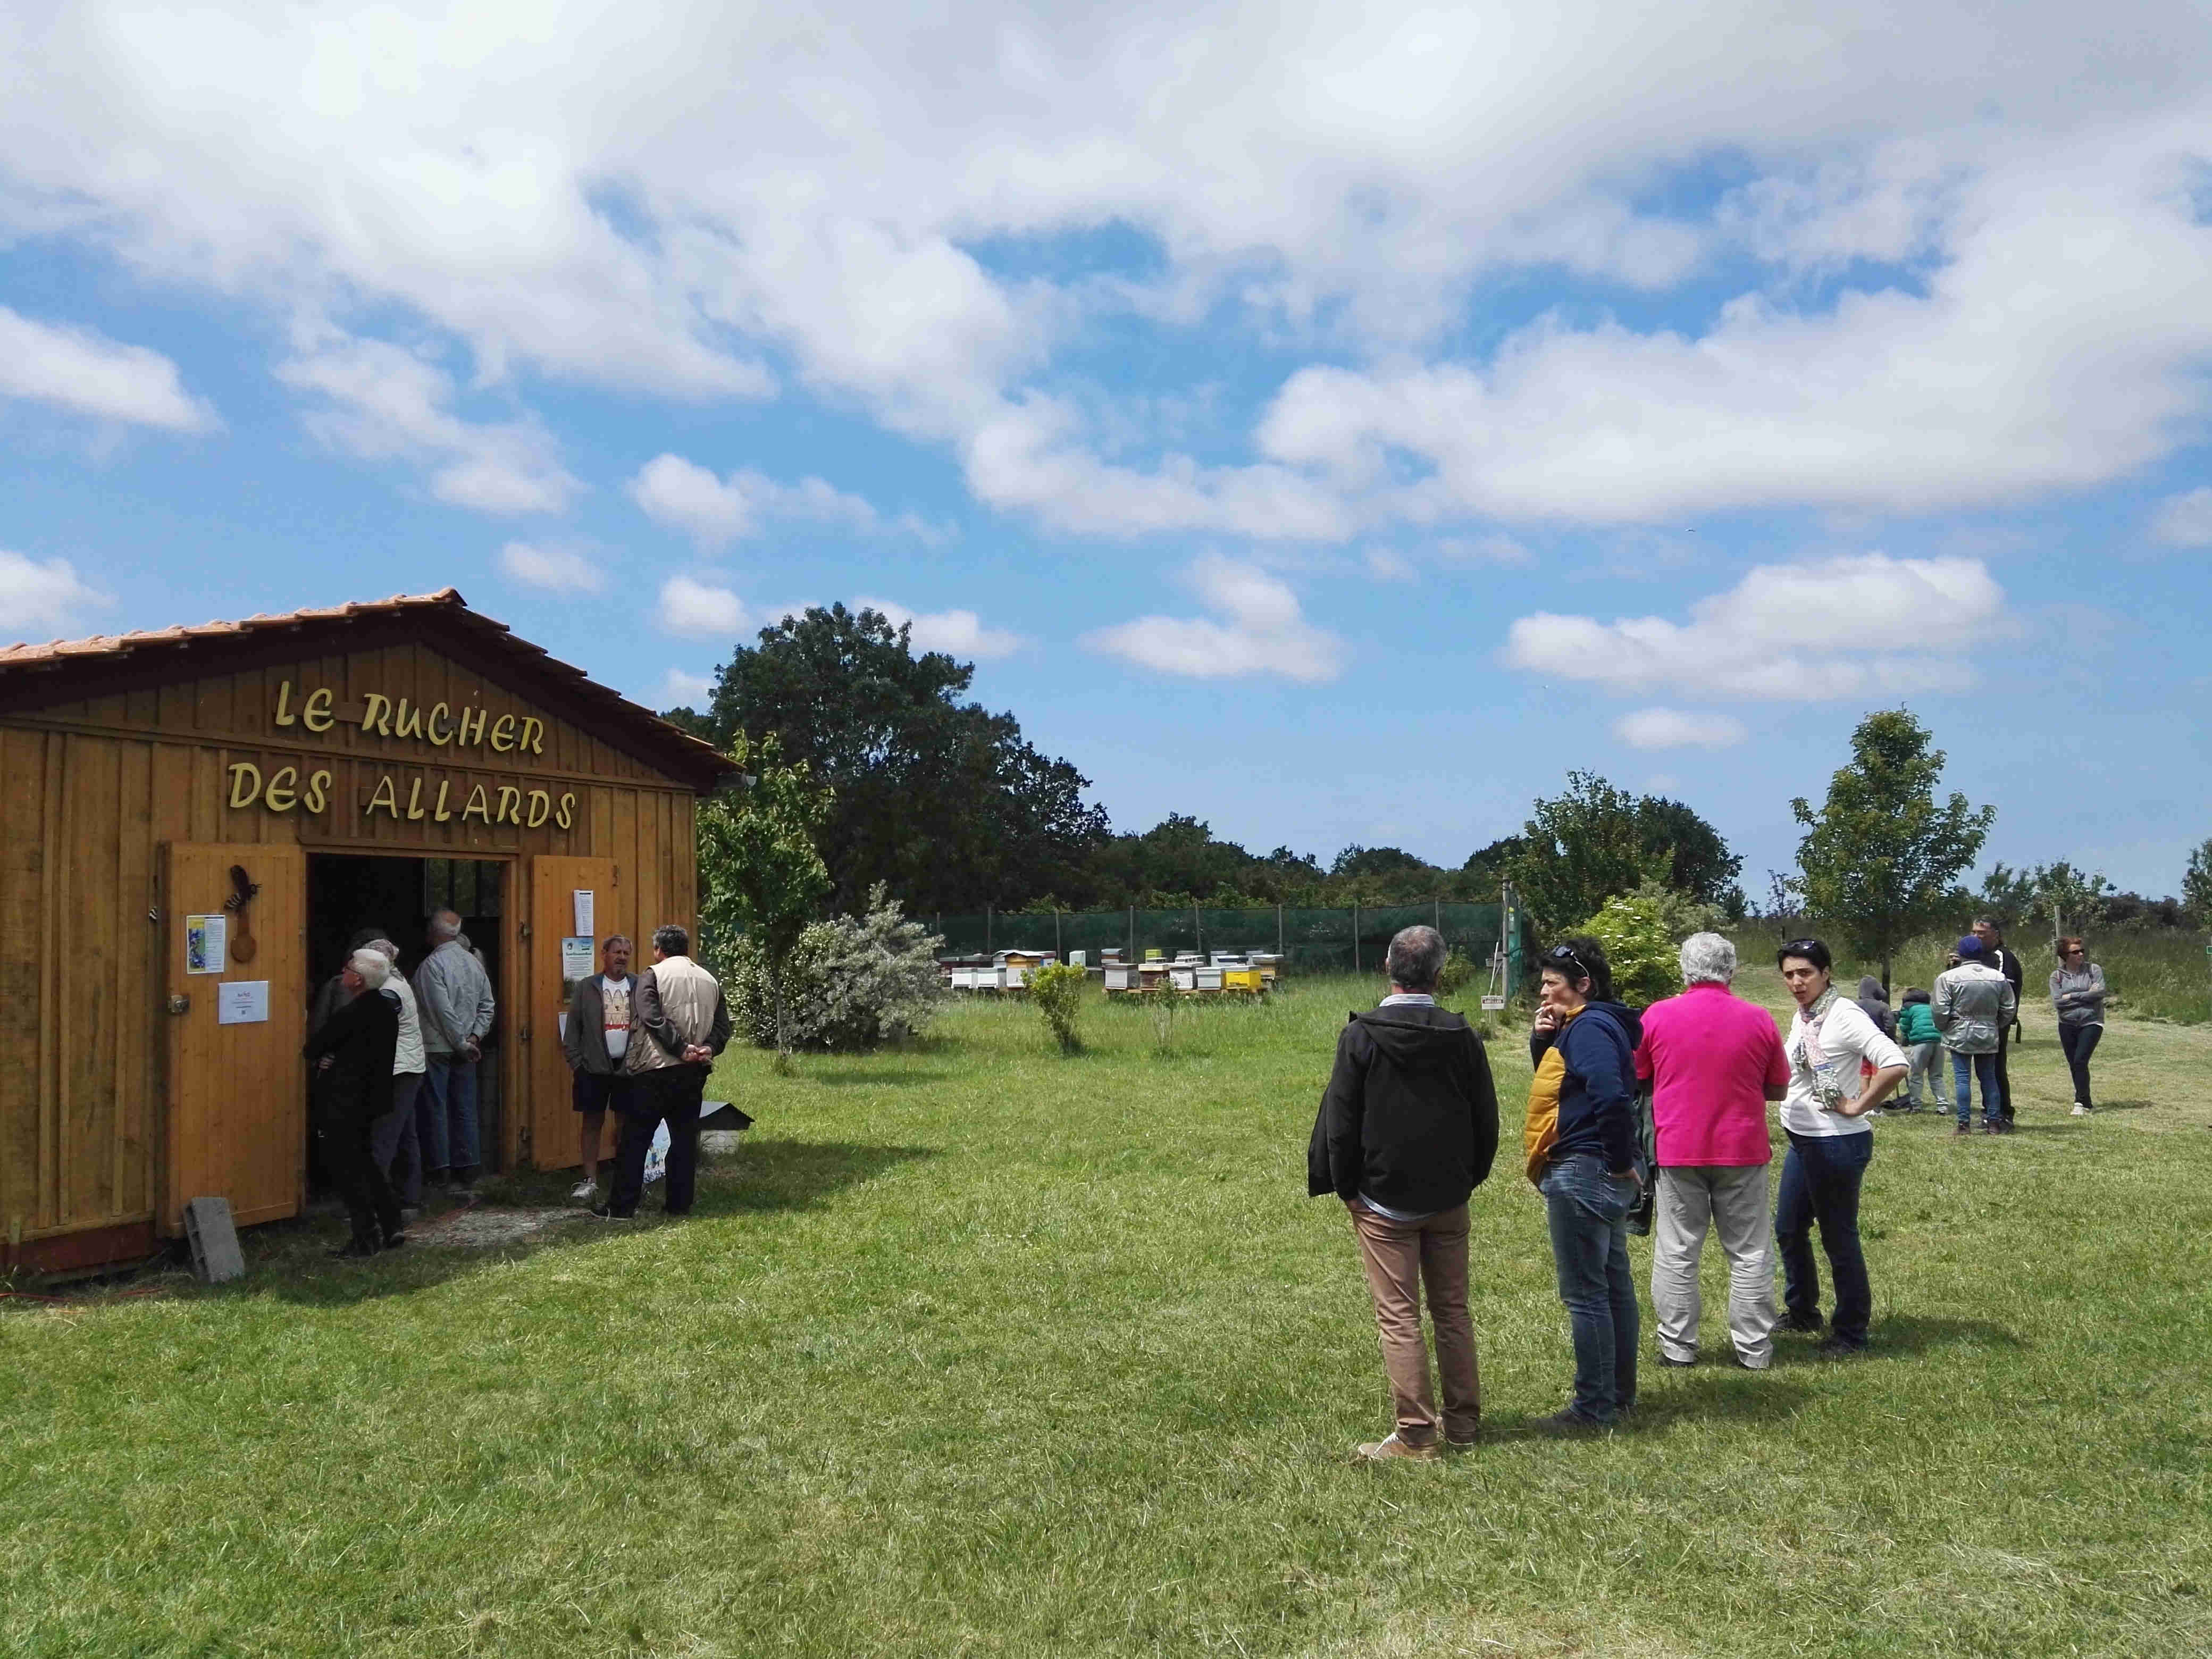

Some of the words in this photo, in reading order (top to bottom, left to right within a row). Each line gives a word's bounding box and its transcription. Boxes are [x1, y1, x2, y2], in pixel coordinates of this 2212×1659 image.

[275, 681, 335, 732] LE
[362, 693, 544, 753] RUCHER
[229, 763, 332, 813] DES
[366, 776, 576, 829] ALLARDS
